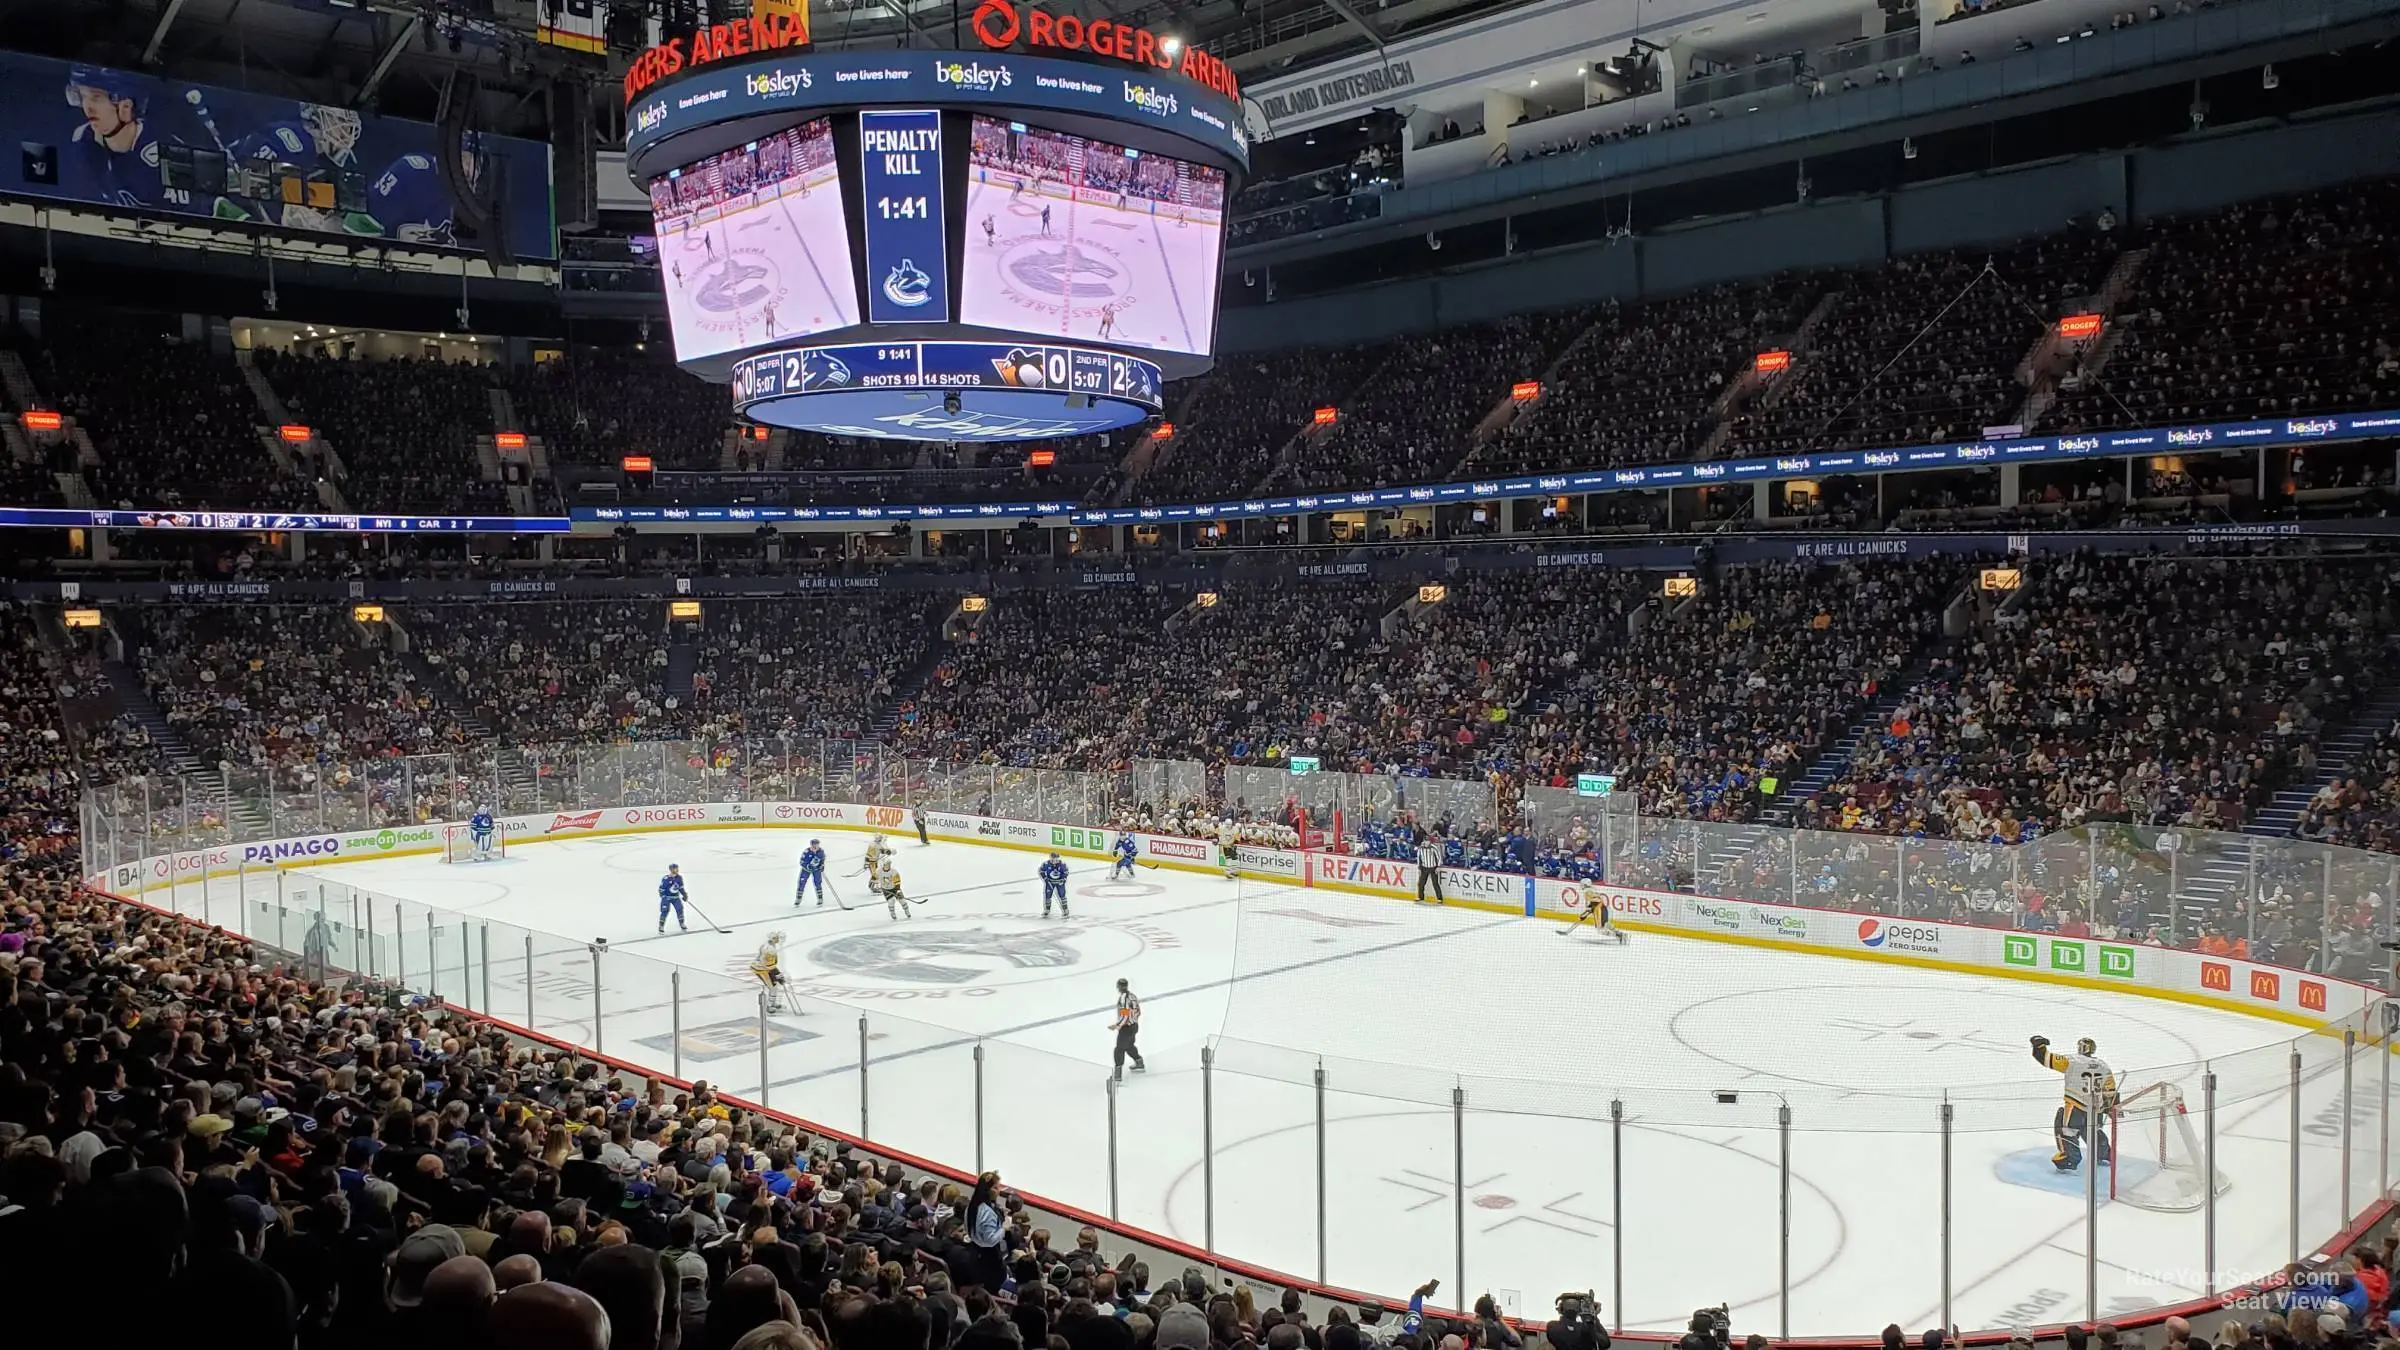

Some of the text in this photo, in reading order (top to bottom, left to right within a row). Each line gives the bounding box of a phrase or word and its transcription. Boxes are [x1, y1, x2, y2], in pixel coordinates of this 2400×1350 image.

[624, 11, 810, 107] OGERS ARENA
[1029, 10, 1241, 104] ROGERS ARENA
[746, 68, 813, 97] bosley's
[935, 60, 1012, 92] bosley's
[1318, 60, 1415, 107] KURTENBACH
[1123, 80, 1178, 117] bosley's
[637, 100, 668, 132] bosley's
[864, 129, 938, 152] PENALTY
[885, 154, 921, 175] KILL
[878, 196, 928, 219] 1:41
[878, 348, 911, 360] 9 1:41
[1075, 355, 1107, 367] 2ND PER
[756, 359, 780, 371] 2ND PER
[786, 357, 801, 388] 2
[1049, 353, 1066, 384] 0
[745, 366, 753, 396] 0
[756, 375, 776, 394] 5:07
[862, 374, 917, 386] SHOTS 19
[924, 373, 981, 385] 14 SHOTS
[1074, 370, 1102, 389] 5:07
[1113, 361, 1125, 391] 2
[2167, 428, 2213, 445] bosley's
[2287, 420, 2338, 437] bosley's
[1956, 444, 1996, 461] bosley's
[2057, 437, 2099, 454] bosley's
[1776, 458, 1810, 473] bosley's
[1864, 452, 1900, 467] bosley's
[1615, 470, 1645, 485] bosley's
[1693, 464, 1725, 479] bosley's
[1539, 477, 1567, 490] bosley's
[201, 515, 212, 527] 0
[218, 518, 239, 528] 5:07
[252, 515, 263, 528] 2
[375, 519, 392, 529] NYI
[419, 520, 440, 529] CAR
[450, 520, 457, 529] 2
[1796, 540, 1907, 557] WE ARE ALL CANUCKS
[1536, 552, 1603, 567] GO CANUCKS GO
[1083, 572, 1136, 583] GO CANUCKS GO
[1298, 562, 1368, 576] WE ARE ALL CANUCKS
[169, 583, 184, 595] WE
[208, 584, 224, 595] ALL
[227, 583, 270, 595] CANUCKS
[490, 581, 556, 592] GO CANUCKS GO
[798, 578, 810, 588] WE
[812, 578, 826, 588] ARE
[844, 577, 879, 588] CANUCKS
[554, 813, 599, 830] Budweiser
[644, 807, 705, 824] ROGERS
[796, 806, 844, 820] TOYOTA
[877, 807, 904, 828] SKIP
[926, 817, 970, 830] AIR CANADA
[982, 820, 1001, 829] PLAY
[982, 827, 1001, 836] NOW
[1008, 826, 1037, 838] SPORTS
[244, 837, 339, 862] PANAGO
[1151, 840, 1206, 859] PHARMASAVE
[1323, 857, 1407, 888] RE/MAX
[1438, 866, 1510, 894] FASKEN
[1602, 890, 1662, 916] OGERS
[1696, 902, 1741, 921] NexGen
[1713, 917, 1740, 930] Energy
[1760, 911, 1806, 929] NexGen
[1778, 926, 1806, 939] Energy
[1888, 923, 1940, 943] pepsi
[1888, 941, 1939, 954] ZERO SUGAR
[2008, 939, 2132, 972] TD TD TD
